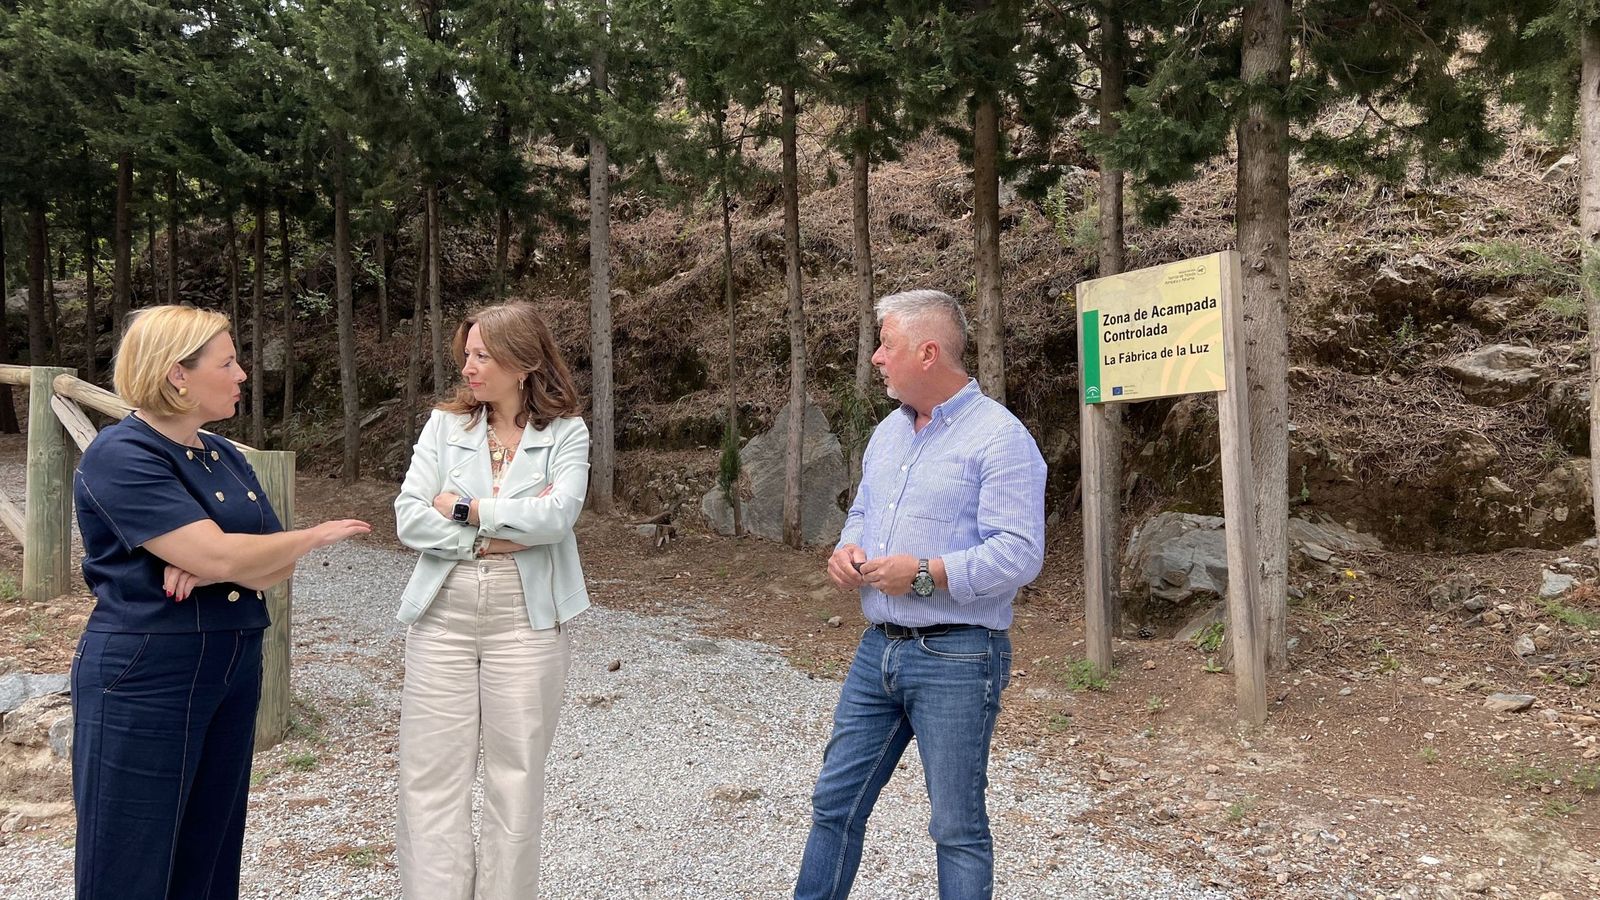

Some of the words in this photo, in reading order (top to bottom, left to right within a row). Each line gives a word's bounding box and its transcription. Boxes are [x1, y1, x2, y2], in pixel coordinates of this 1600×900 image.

[1103, 313, 1130, 326] Zona
[1134, 309, 1148, 321] de
[1151, 296, 1217, 318] Acampada
[1103, 323, 1168, 343] Controlada
[1104, 355, 1116, 366] La
[1119, 351, 1157, 364] Fábrica
[1160, 347, 1174, 358] de
[1176, 345, 1186, 356] la
[1190, 343, 1210, 355] Luz
